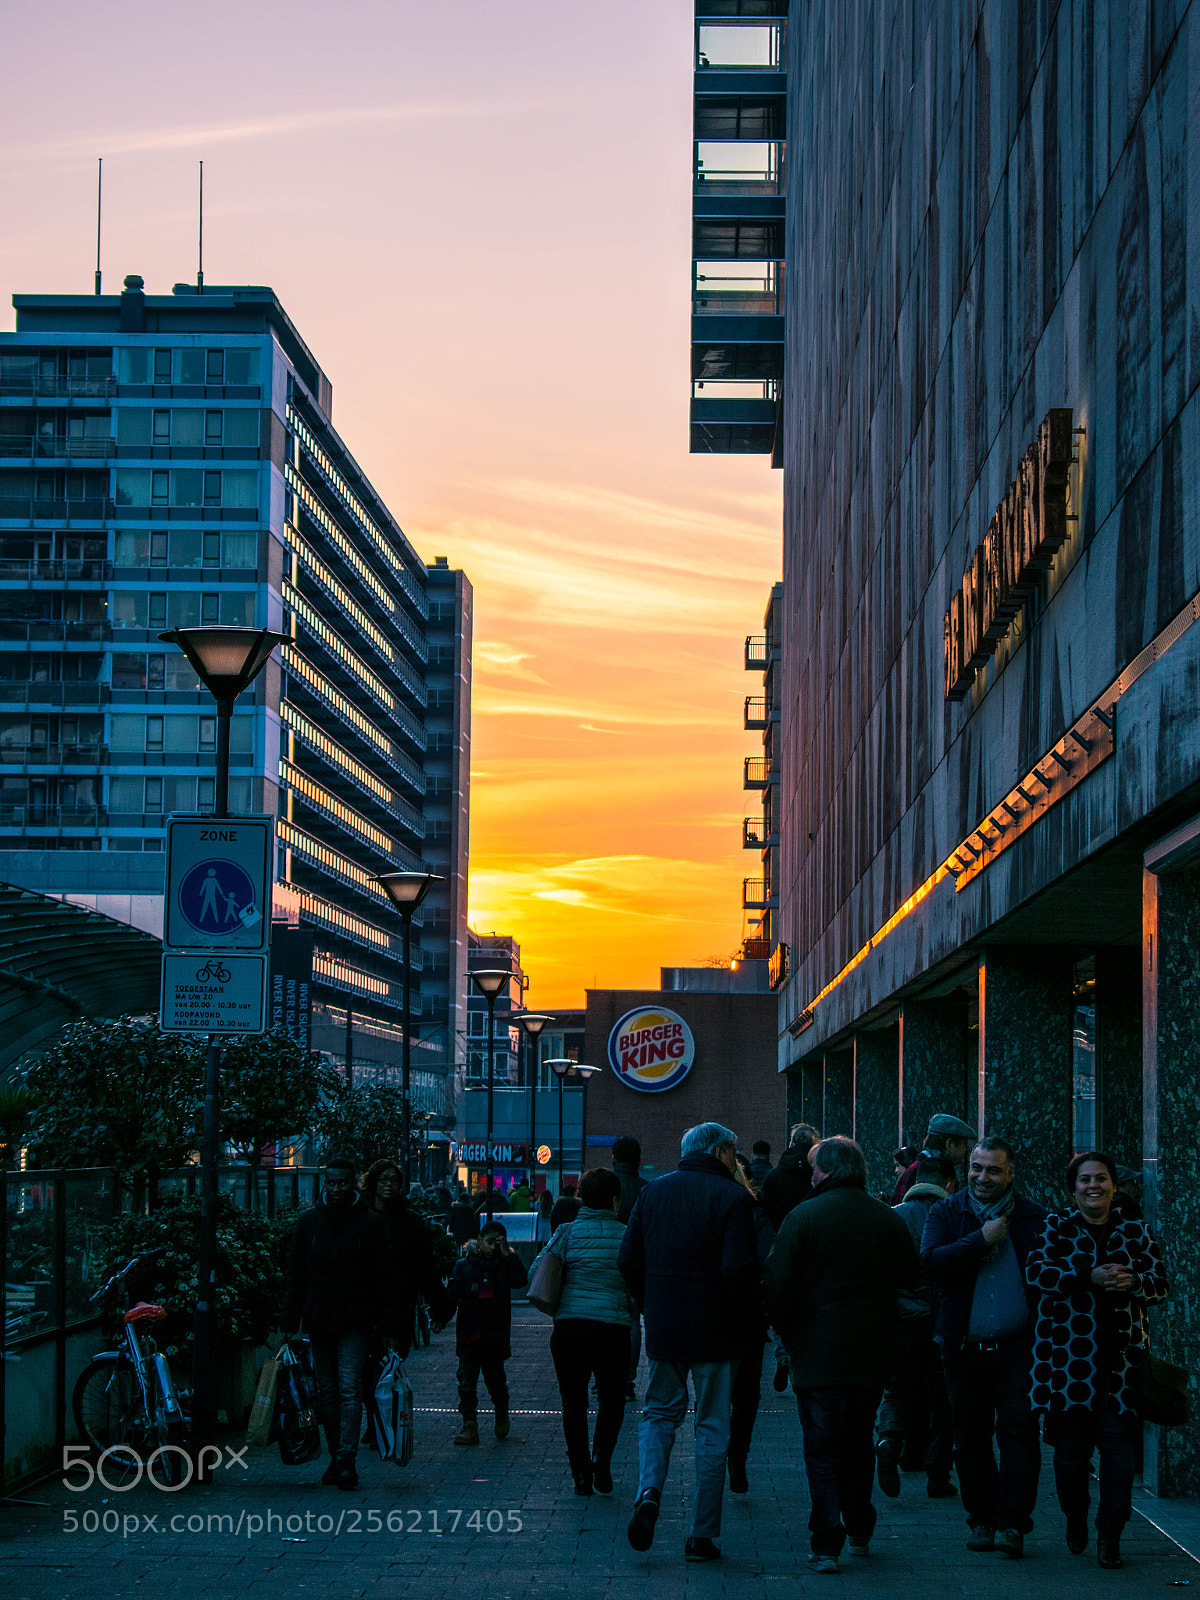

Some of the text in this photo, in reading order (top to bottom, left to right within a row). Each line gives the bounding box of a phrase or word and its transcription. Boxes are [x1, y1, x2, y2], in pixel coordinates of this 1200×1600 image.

[200, 830, 237, 842] ZONE
[175, 985, 224, 993] TOEGESTAAN
[273, 974, 284, 1030] RIVER ISLA
[286, 979, 296, 1007] RIVER
[298, 983, 309, 1010] RIVER
[619, 1023, 683, 1052] BURGER
[620, 1037, 685, 1074] KING
